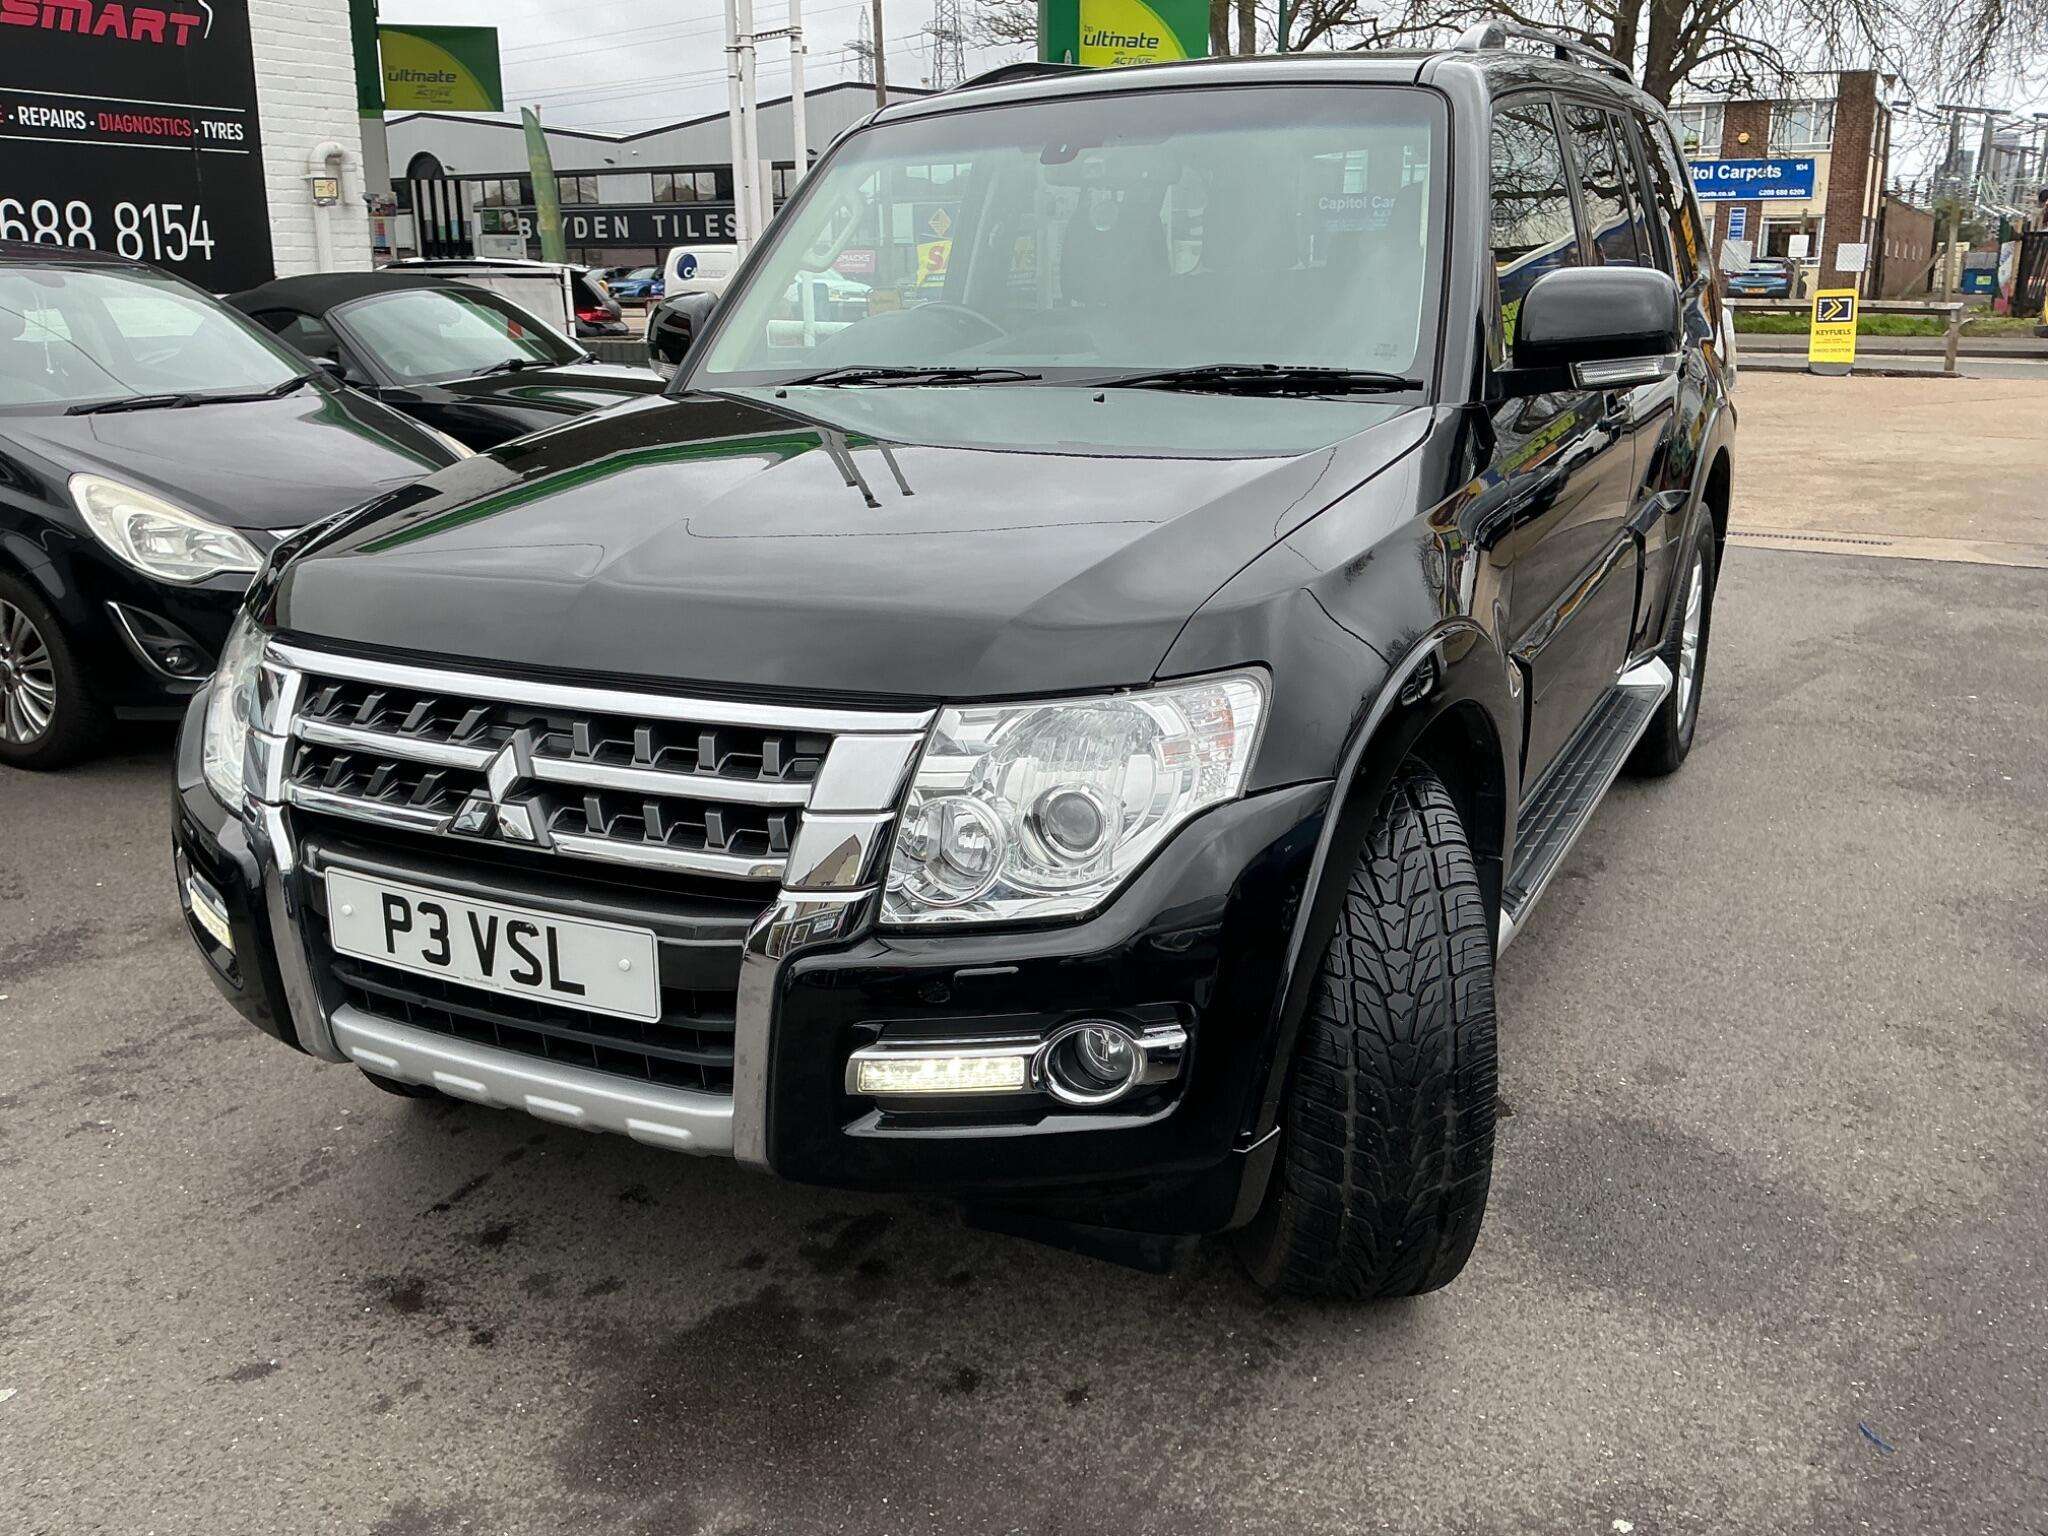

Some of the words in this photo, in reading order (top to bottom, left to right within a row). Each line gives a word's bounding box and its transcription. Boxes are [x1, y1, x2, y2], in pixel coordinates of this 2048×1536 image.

[0, 0, 201, 46] SMART
[1083, 30, 1160, 49] ultimate
[387, 69, 457, 83] ultimate
[18, 106, 86, 130] REPAIRS
[98, 113, 192, 137] DIAGNOSTICS
[201, 121, 244, 141] TYRES
[1718, 164, 1782, 182] Carpets
[114, 202, 215, 261] 8154
[652, 213, 737, 238] TILES
[381, 892, 451, 967] P3
[467, 911, 585, 996] VSL
